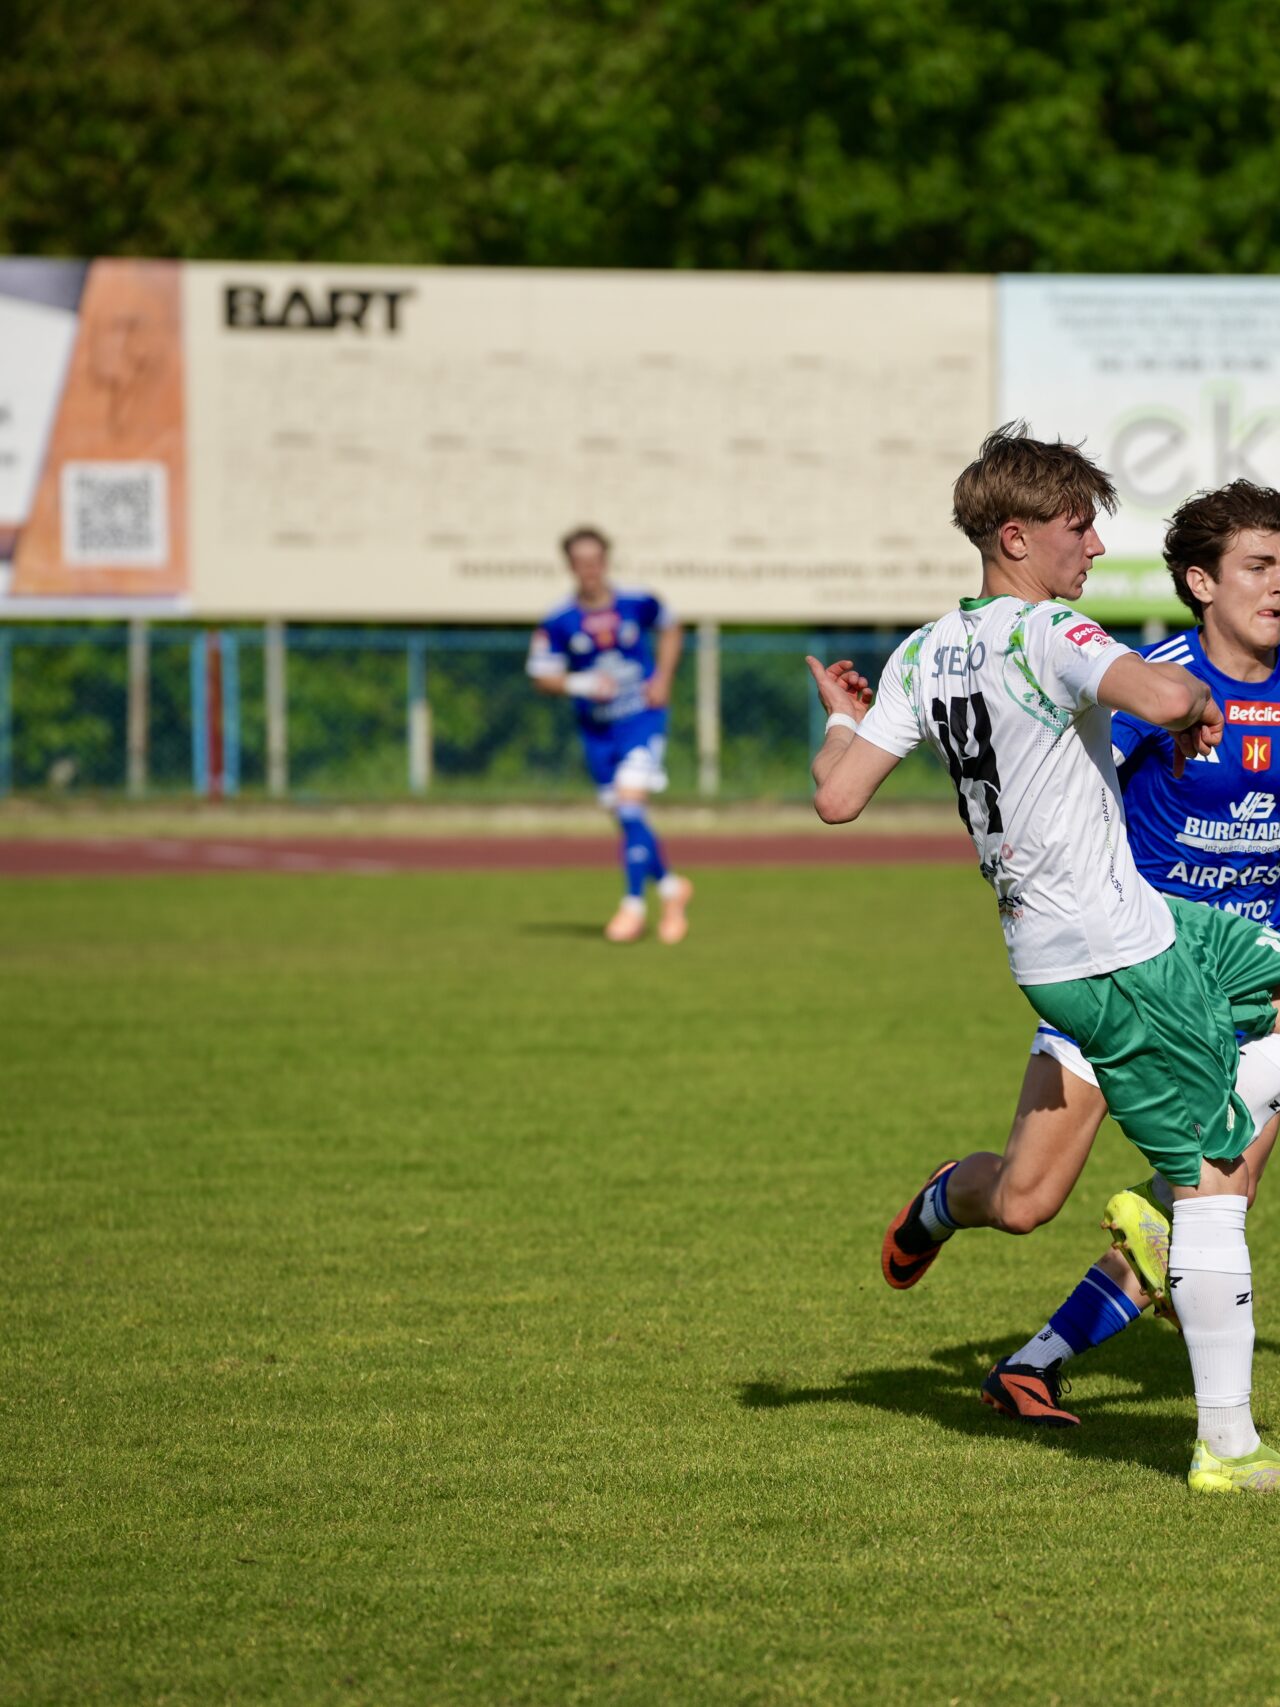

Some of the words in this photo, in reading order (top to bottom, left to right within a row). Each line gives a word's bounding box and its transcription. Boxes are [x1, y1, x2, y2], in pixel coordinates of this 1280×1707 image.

[223, 285, 413, 333] BART
[1072, 626, 1103, 642] Betc
[1101, 787, 1111, 822] RAZEM
